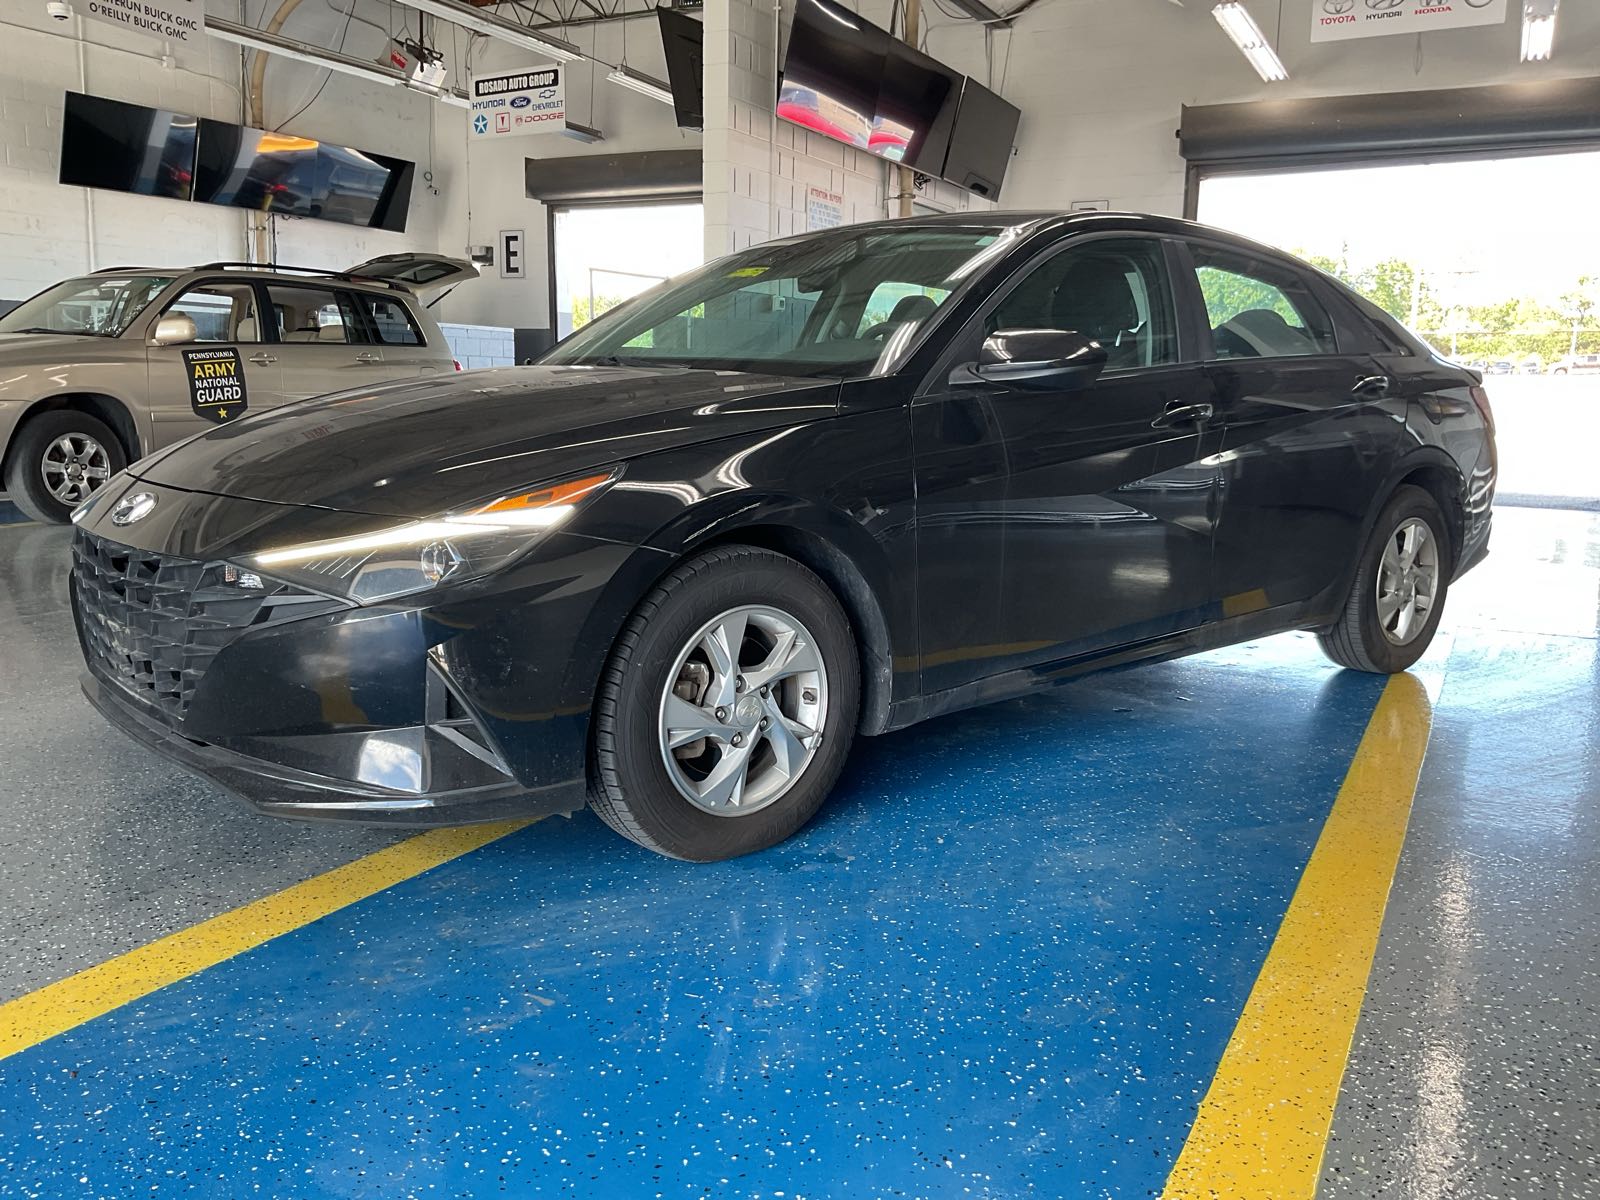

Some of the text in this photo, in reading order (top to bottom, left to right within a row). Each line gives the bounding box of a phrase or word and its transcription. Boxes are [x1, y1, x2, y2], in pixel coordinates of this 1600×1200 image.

[1365, 11, 1403, 21] HYUNDAI
[1415, 6, 1452, 15] HONDA
[89, 2, 187, 41] O'REILLY BUICK GMC
[145, 6, 173, 23] BUICK
[176, 16, 197, 31] GMC
[1320, 15, 1356, 26] TOYOTA
[479, 72, 555, 94] ROSADO AUTO GROUP
[472, 98, 506, 110] HYUNDAI
[512, 97, 529, 108] Ford
[532, 100, 563, 111] CHEVROLET
[524, 112, 564, 123] DODGE
[505, 235, 519, 273] E
[188, 351, 234, 360] PENNSYLVANIA
[195, 363, 235, 378] ARMY
[195, 376, 240, 389] NATIONAL
[197, 387, 241, 402] GUARD
